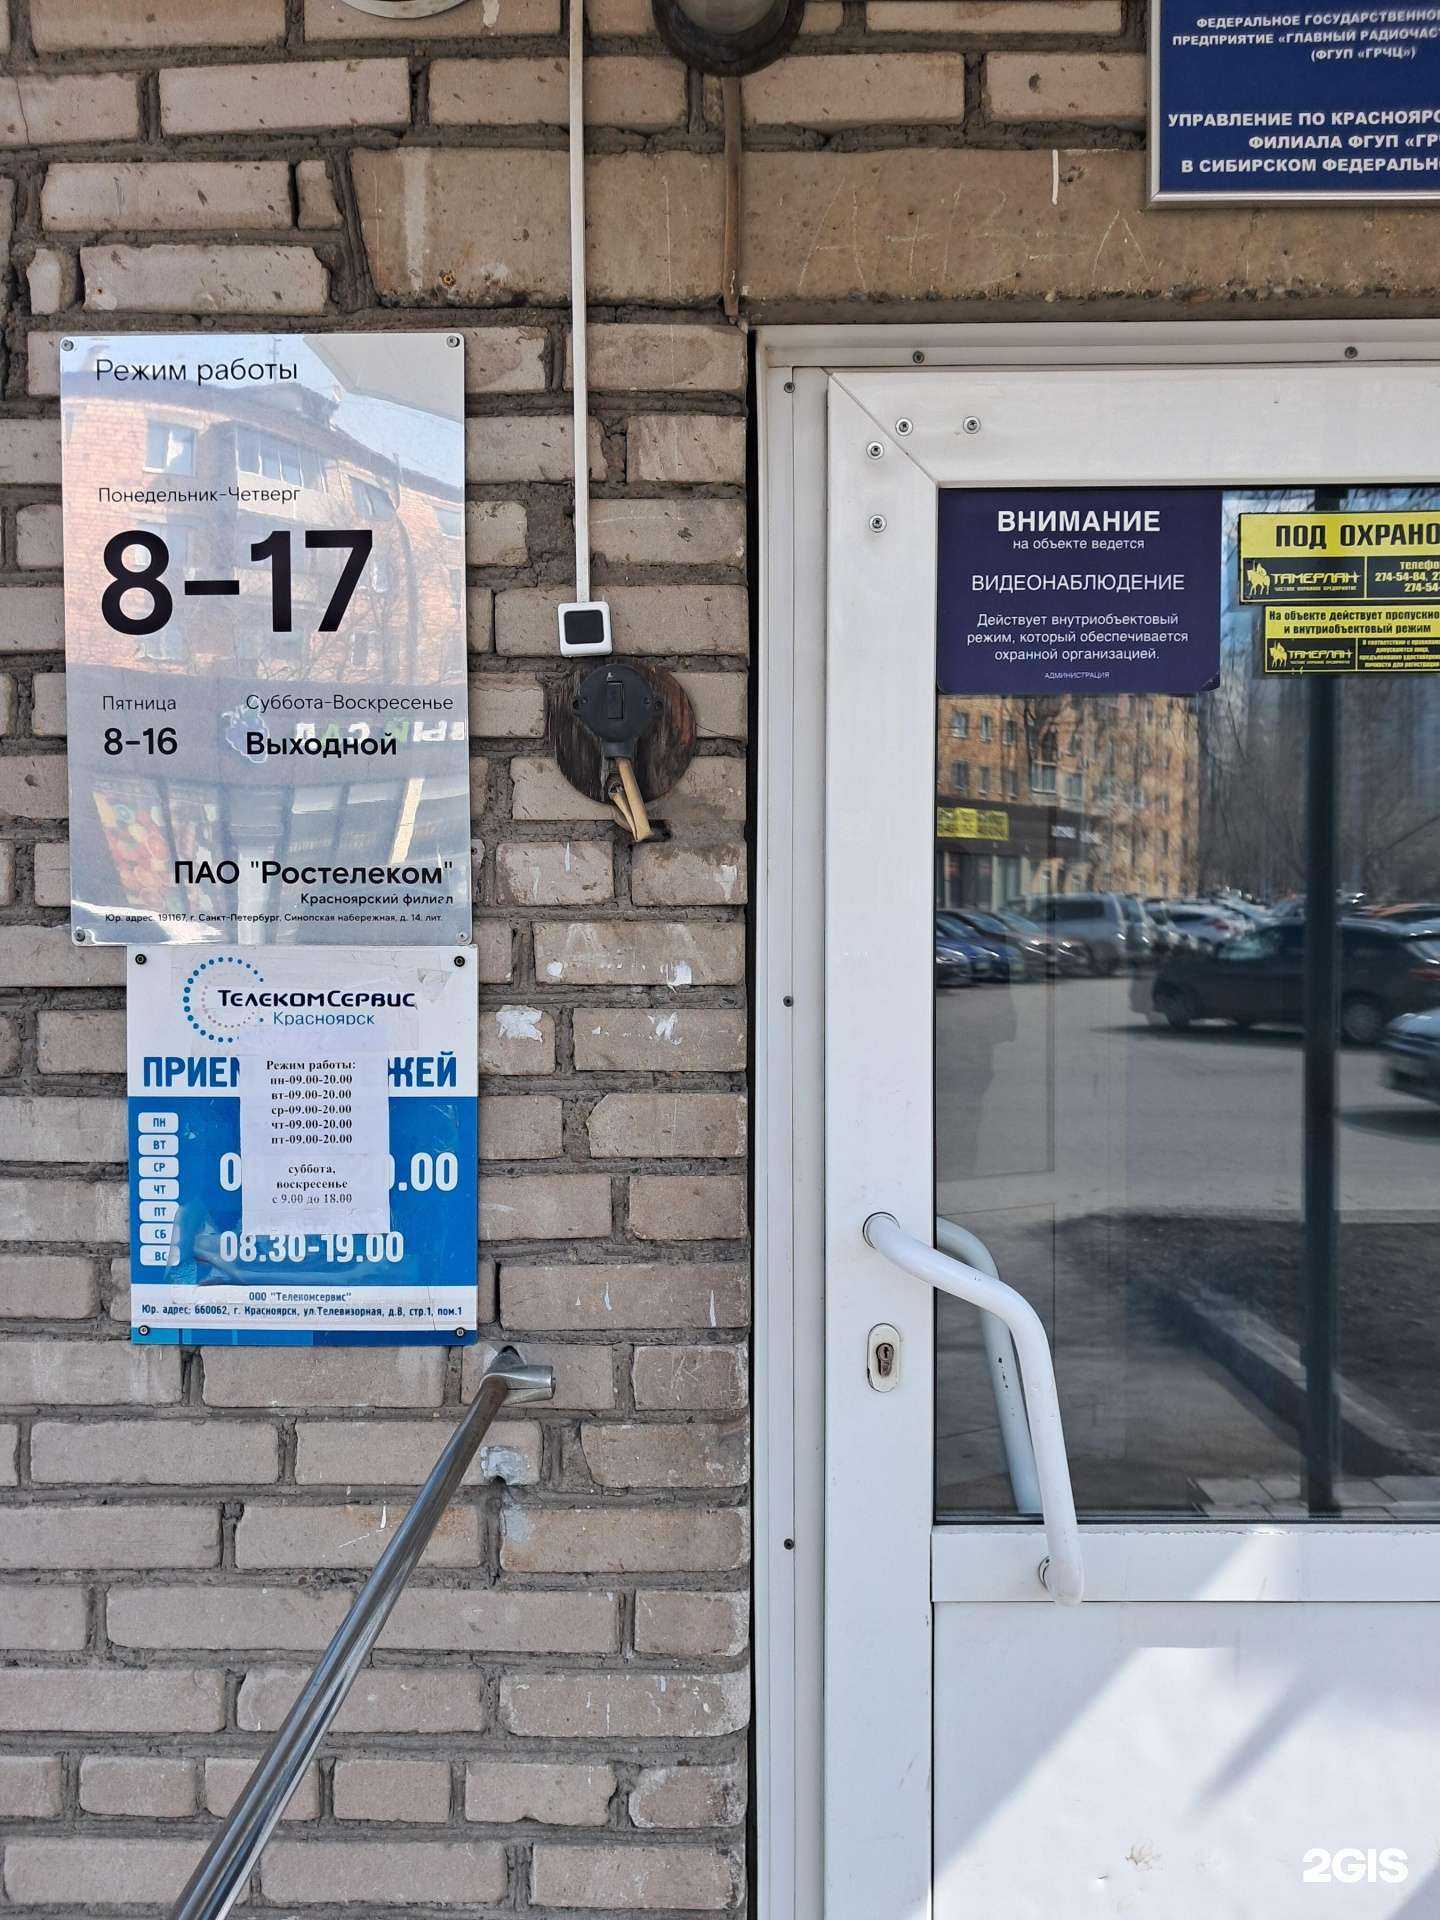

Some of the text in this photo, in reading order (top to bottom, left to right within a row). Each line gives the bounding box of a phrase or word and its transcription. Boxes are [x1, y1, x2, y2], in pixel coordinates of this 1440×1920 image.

[1197, 16, 1300, 29] ФЕДЕРАЛЬНОЕ
[1172, 34, 1274, 46] ПРЕДПРИЯТИЕ
[1278, 29, 1356, 43] «ГЛАВНЫЙ
[1311, 46, 1416, 62] (ФГУП «ГРЧЦ»)
[1168, 113, 1292, 127] УПРАВЛЕНИЕ
[1299, 112, 1325, 126] ПО
[1249, 134, 1440, 149] ФИЛИАЛА ФГУП «ГР
[1181, 157, 1440, 174] В СИБИРСКОМ ФЕДЕРАЛЬН
[96, 358, 299, 386] Режим работы
[98, 486, 300, 504] Понедельник-Четверг
[997, 510, 1161, 533] ВНИМАНИЕ
[1276, 523, 1440, 550] ПОД ОХРАНО
[1013, 538, 1145, 550] на объекте ведется
[971, 574, 1185, 594] ВИДЕОНАБЛЮДЕНИЕ
[1270, 571, 1361, 584] ТАМЕРЛАН
[977, 612, 1178, 628] Действует внутриобъектовый
[1269, 611, 1281, 620] На
[1284, 610, 1327, 621] объекте
[1329, 609, 1383, 622] действует
[1284, 623, 1431, 635] и внутриобъектовый режим
[967, 631, 1188, 645] режим, который обеспечивается
[994, 648, 1160, 662] охранной организацией.
[1287, 649, 1354, 659] ТАМЕРЛАН
[102, 694, 177, 714] Пятница
[246, 694, 453, 714] Суббота-Воскресенье
[104, 727, 178, 756] 8-16
[246, 731, 397, 758] Выходной
[175, 859, 453, 885] ПАО "Ростелеком"
[300, 893, 399, 906] Красноярский
[284, 913, 335, 922] Синопская
[273, 1011, 375, 1026] Красноярск
[266, 1060, 356, 1072] Режим работы:
[270, 1075, 352, 1085] пн-09.00-20.00
[271, 1090, 352, 1100] вт-09.00-20.00
[271, 1105, 352, 1117] ср-09.00-20.00
[153, 1118, 166, 1127] ПН
[271, 1119, 352, 1129] чт-09.00-20.00
[153, 1140, 167, 1150] ВТ
[271, 1134, 352, 1144] пт-09.00-20.00
[153, 1163, 165, 1172] СР
[288, 1164, 336, 1175] суббота,
[153, 1185, 167, 1194] ЧТ
[276, 1181, 348, 1191] воскресенье
[272, 1193, 352, 1205] с 9.00 до 18.00
[154, 1207, 167, 1216] ПТ
[154, 1229, 167, 1239] СБ
[220, 1231, 404, 1263] 08.30-19.00
[155, 1252, 167, 1261] ВС
[249, 1292, 352, 1302] ООО "Телекомсервис"
[142, 1304, 159, 1315] Юр.
[244, 1306, 300, 1317] Красноярск,
[303, 1306, 385, 1317] ул.Телевизорная,
[409, 1307, 434, 1317] стр.1,
[438, 1307, 462, 1316] пом.1
